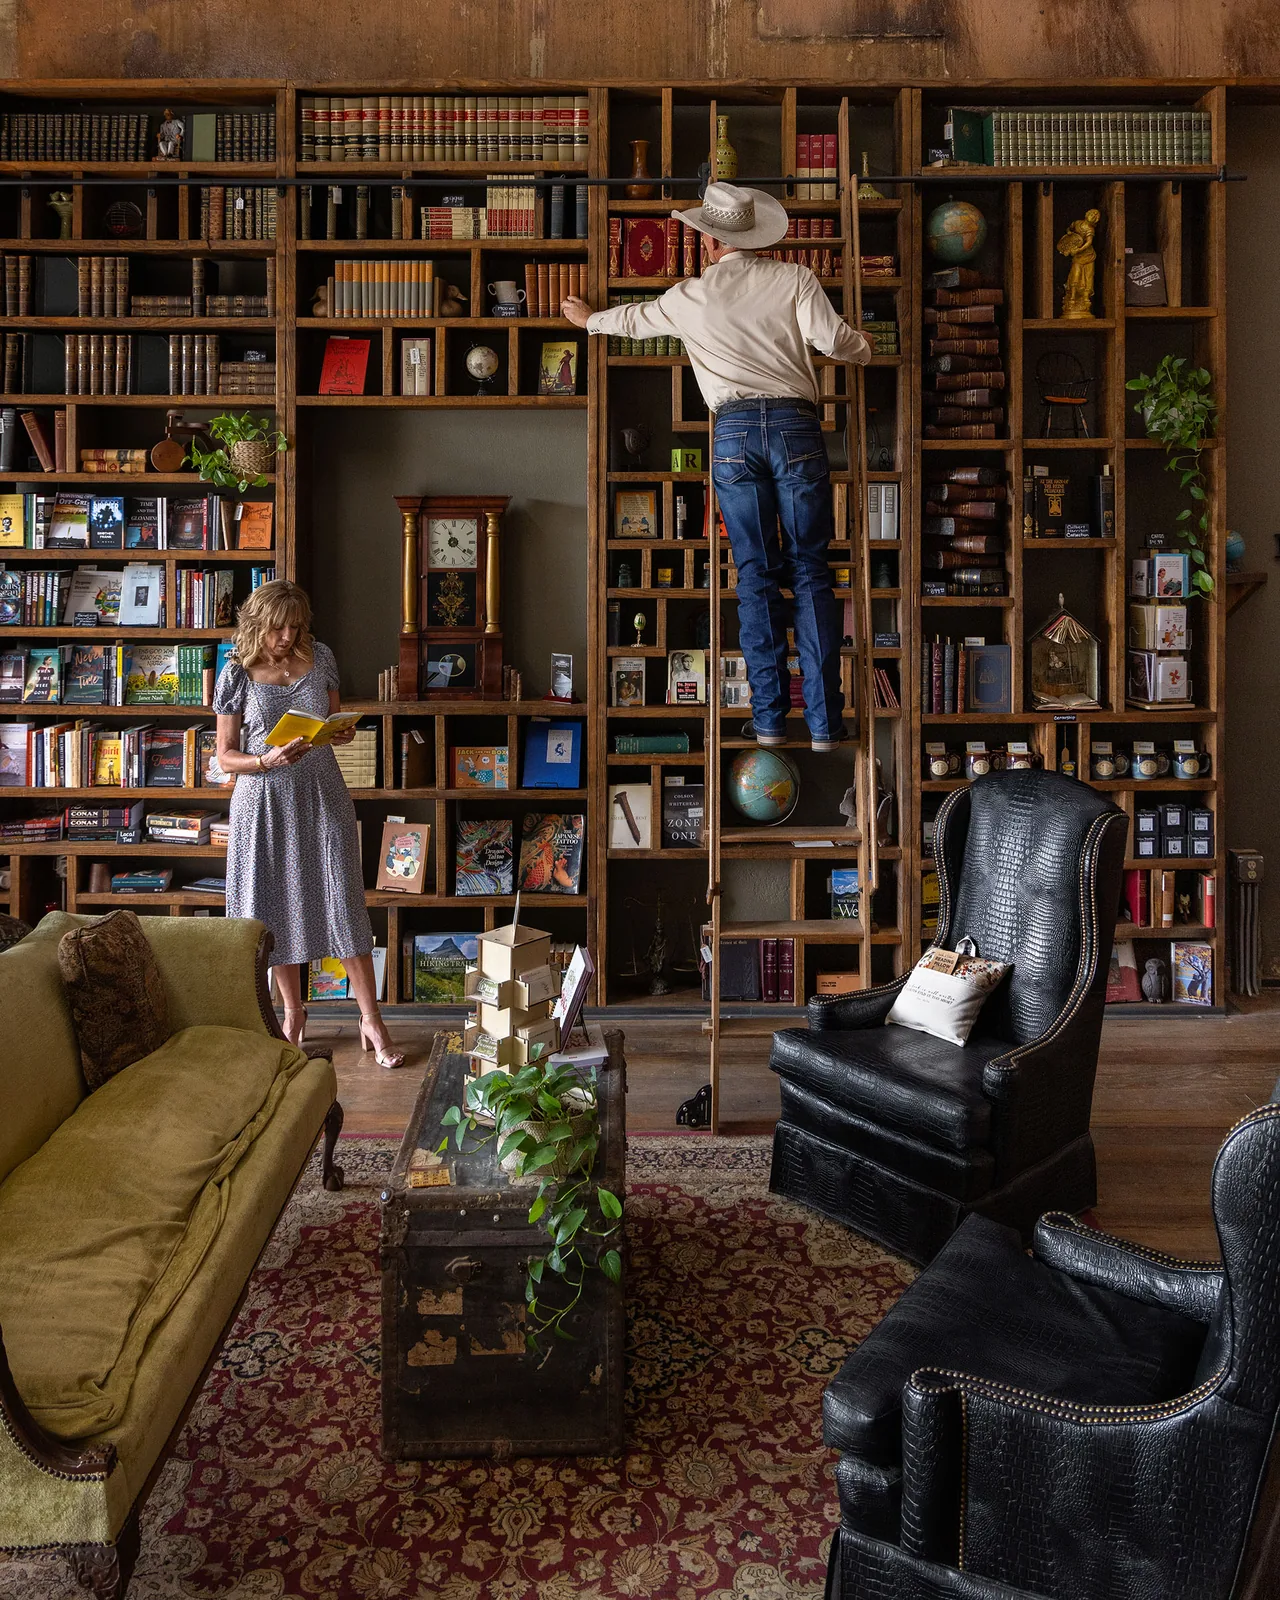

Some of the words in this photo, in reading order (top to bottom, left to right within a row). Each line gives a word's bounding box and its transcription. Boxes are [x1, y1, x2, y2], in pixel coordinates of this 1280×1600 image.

[684, 453, 698, 468] R
[76, 674, 100, 689] Time
[668, 818, 700, 827] ZONE
[671, 832, 696, 840] ONE
[935, 956, 954, 964] READING
[934, 961, 951, 969] PILLOW
